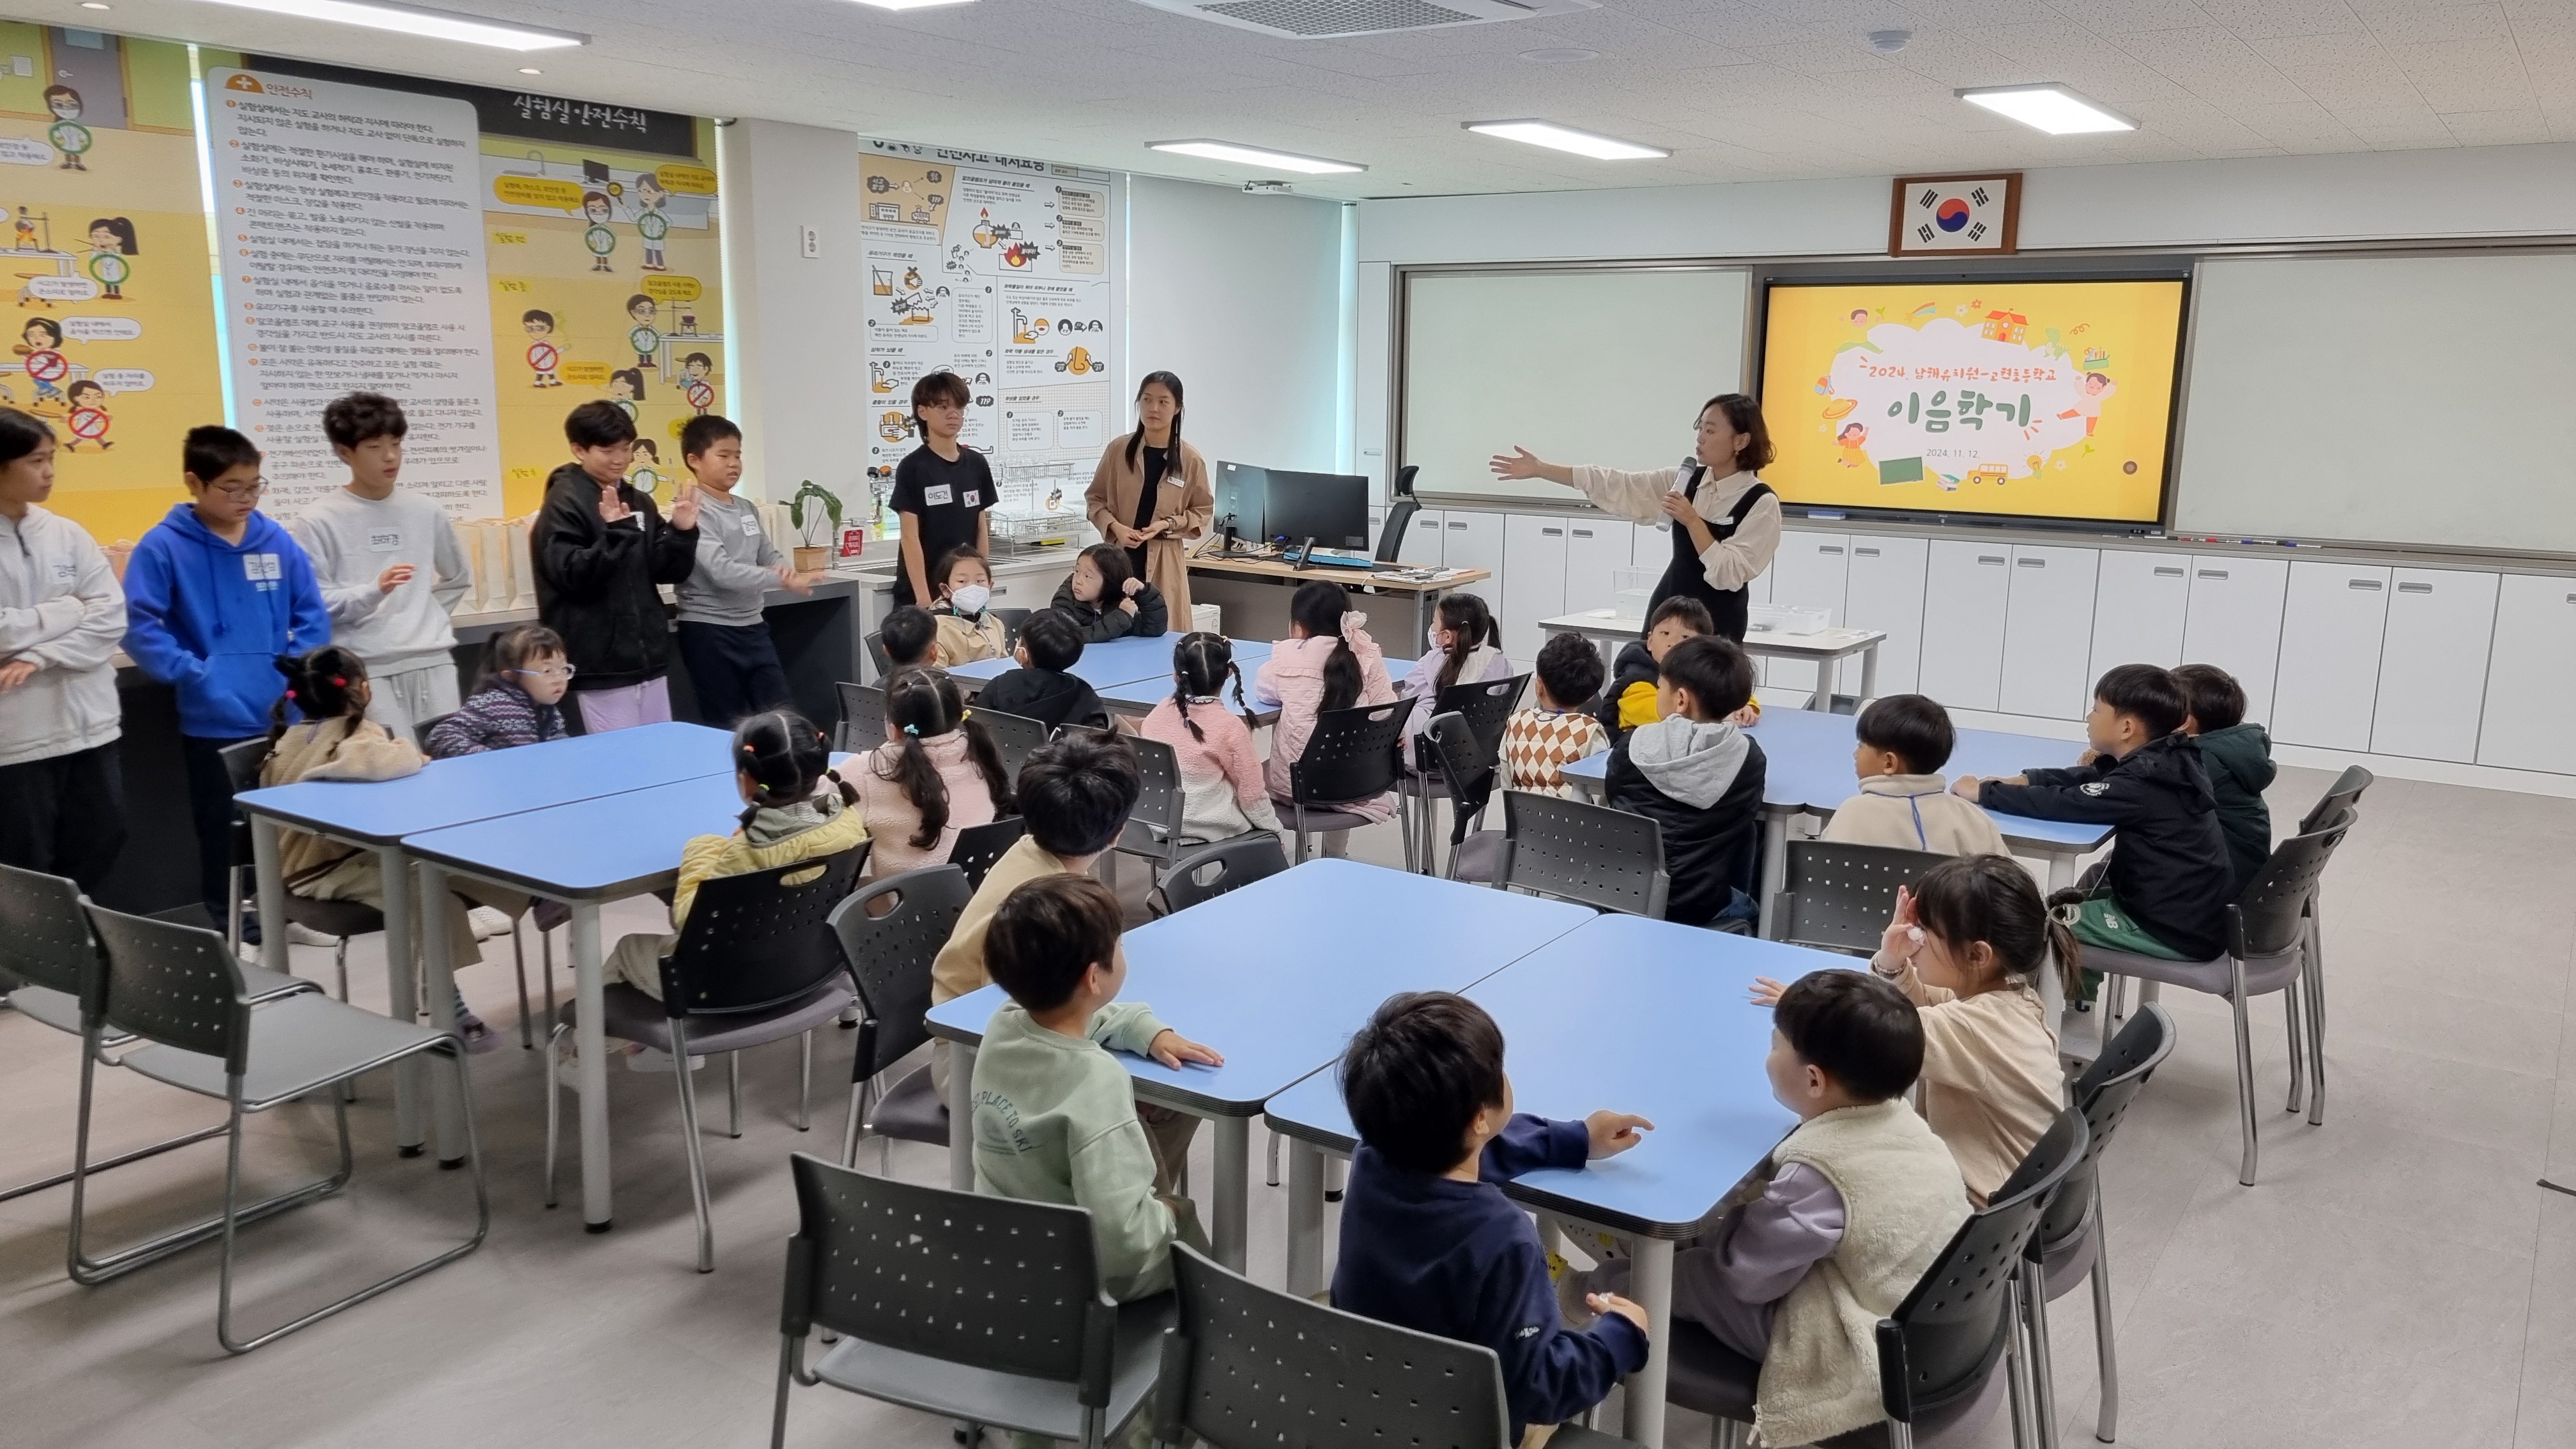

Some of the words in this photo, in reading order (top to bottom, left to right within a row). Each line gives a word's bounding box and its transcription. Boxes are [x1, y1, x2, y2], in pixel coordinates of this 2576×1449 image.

[265, 83, 312, 100] 안전수칙
[238, 101, 289, 116] 실험실에서는
[292, 108, 308, 118] 지도
[311, 111, 335, 121] 교사의
[514, 95, 569, 124] 실험실
[575, 103, 647, 134] 안전수칙
[319, 123, 346, 134] 하거나
[348, 126, 364, 135] 지도
[365, 128, 381, 138] 교사
[246, 208, 257, 217] 긴
[249, 234, 275, 245] 실험실
[250, 249, 268, 259] 실험
[252, 275, 279, 286] 실험실
[440, 323, 456, 332] 사용
[457, 324, 466, 332] 시
[291, 330, 319, 339] 가지고
[319, 331, 346, 340] 반드시
[347, 332, 365, 341] 지도
[365, 332, 390, 341] 교사의
[392, 333, 415, 342] 지시를
[260, 358, 279, 367] 모든
[279, 358, 305, 367] 시약은
[385, 360, 401, 368] 모든
[401, 360, 418, 369] 실험
[1869, 366, 1908, 380] 2024.
[1915, 367, 2057, 383] 남해유치원-고현초등학교
[1887, 390, 2030, 433] 이음학기
[285, 424, 311, 432] 손으로
[293, 435, 319, 443] 실험실
[1926, 448, 1949, 458] 2024.
[1954, 449, 1965, 458] 11.
[1968, 450, 1980, 459] 12.
[427, 456, 460, 464] 있으므로
[307, 471, 328, 480] 한다.
[454, 480, 470, 488] 다른
[928, 490, 948, 500] 이도건
[982, 1091, 1013, 1114] PLACE
[1006, 1110, 1019, 1128] TO
